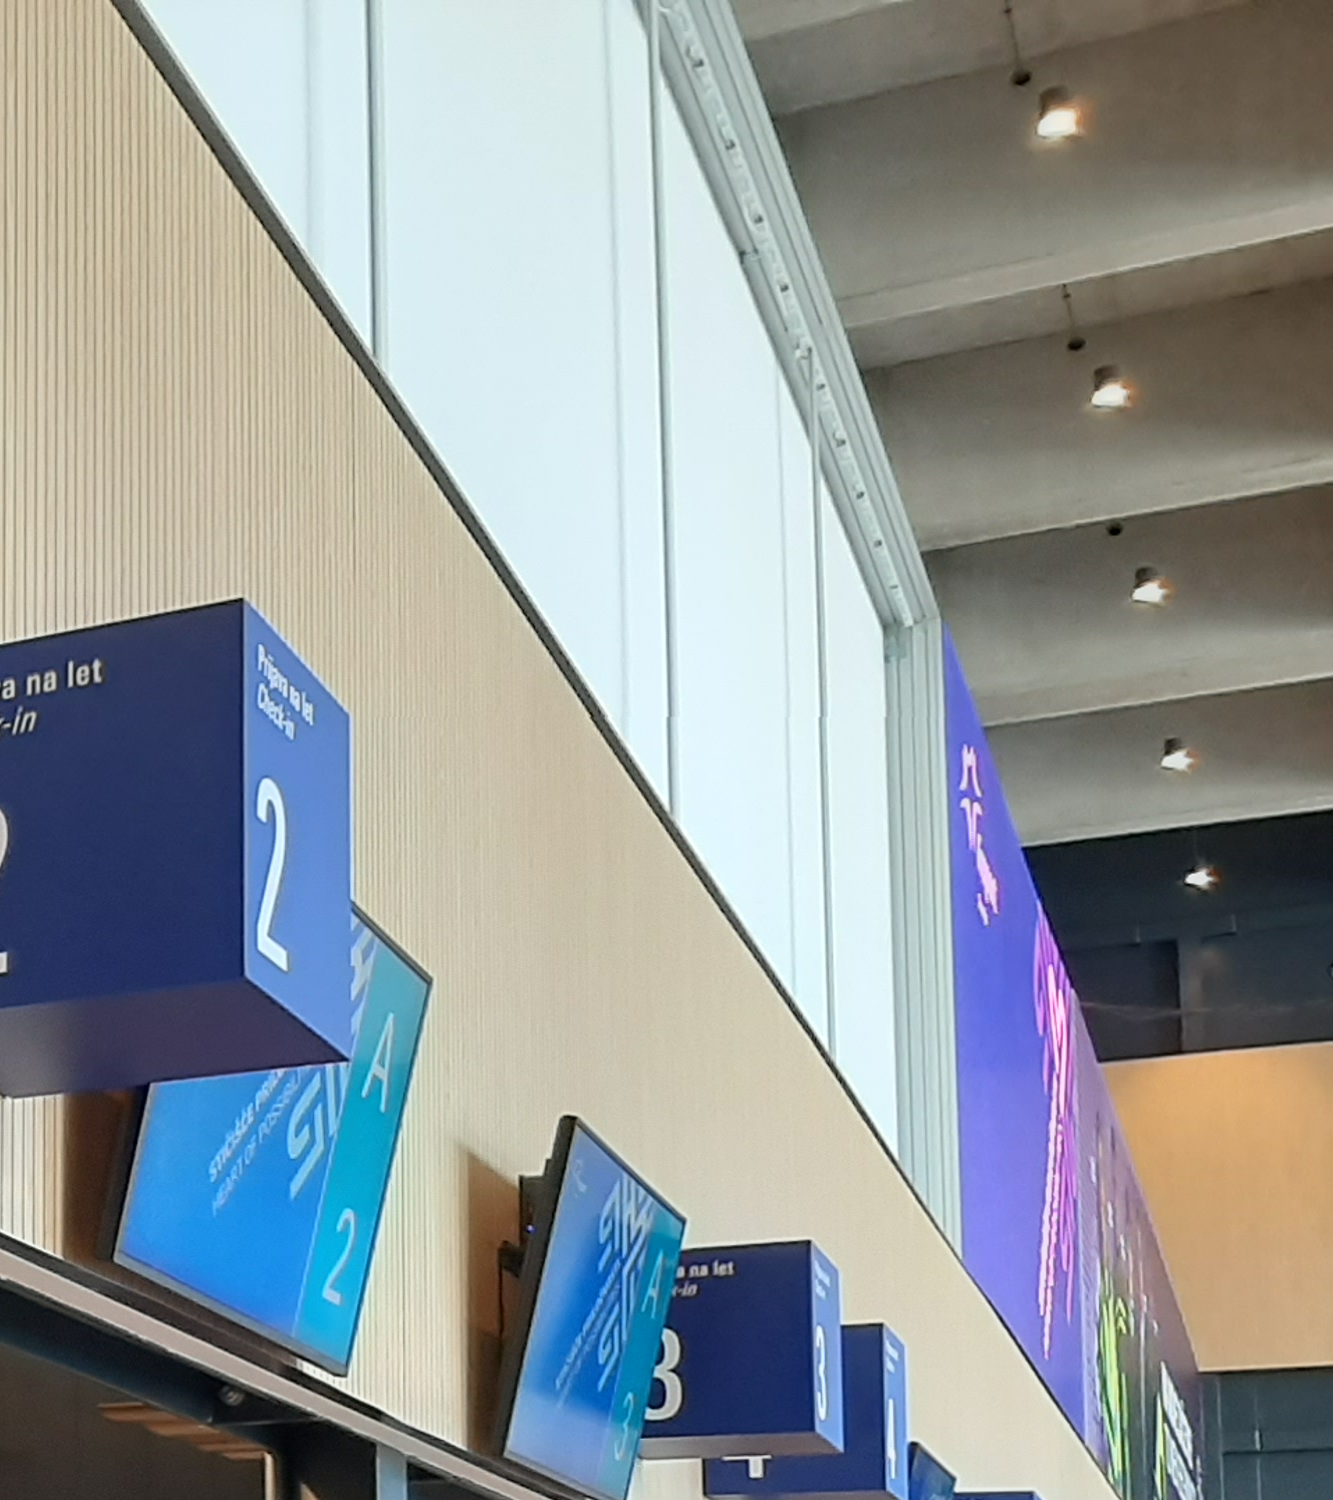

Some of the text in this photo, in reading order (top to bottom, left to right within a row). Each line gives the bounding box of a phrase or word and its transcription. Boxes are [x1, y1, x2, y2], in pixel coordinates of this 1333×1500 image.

[26, 669, 58, 697] na
[67, 658, 103, 689] let
[256, 776, 290, 973] 2
[361, 1012, 395, 1113] A
[322, 1207, 357, 1305] 2
[641, 1248, 665, 1319] A
[816, 1324, 830, 1422] 3
